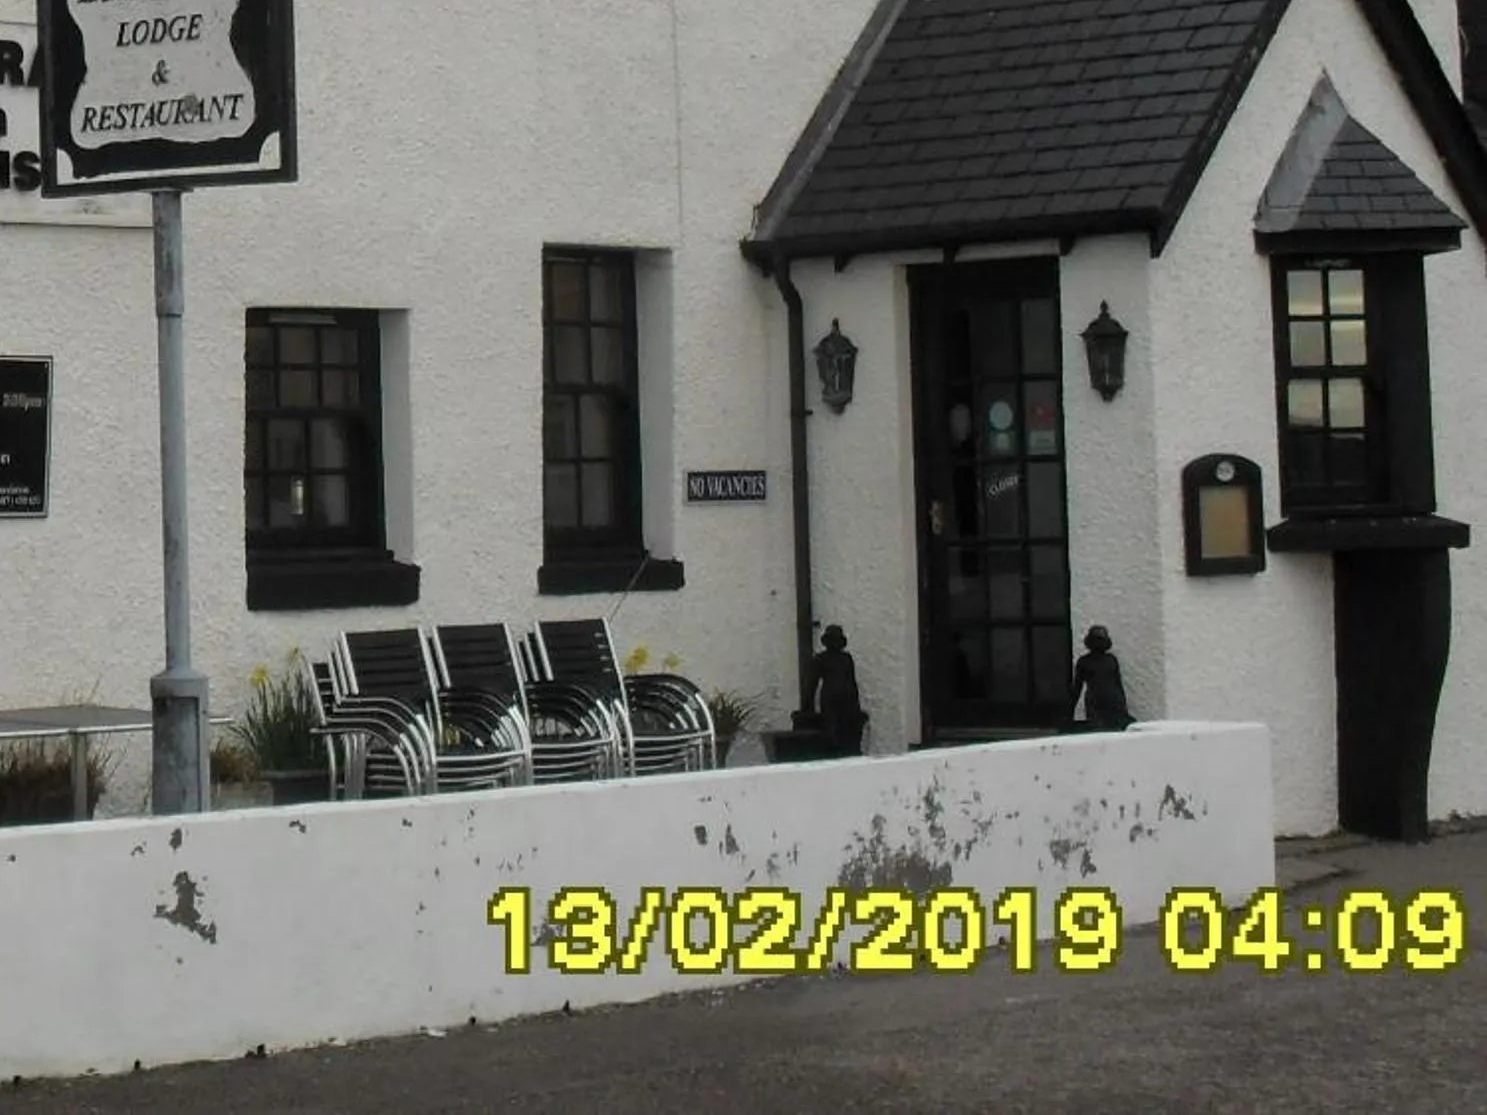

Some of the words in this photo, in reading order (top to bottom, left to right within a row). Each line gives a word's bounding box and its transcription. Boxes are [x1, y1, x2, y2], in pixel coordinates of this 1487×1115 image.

[116, 13, 204, 48] LODGE
[151, 60, 171, 84] &
[81, 93, 244, 134] RESTAURANT
[690, 476, 704, 497] NO
[707, 475, 764, 496] VACANCIES
